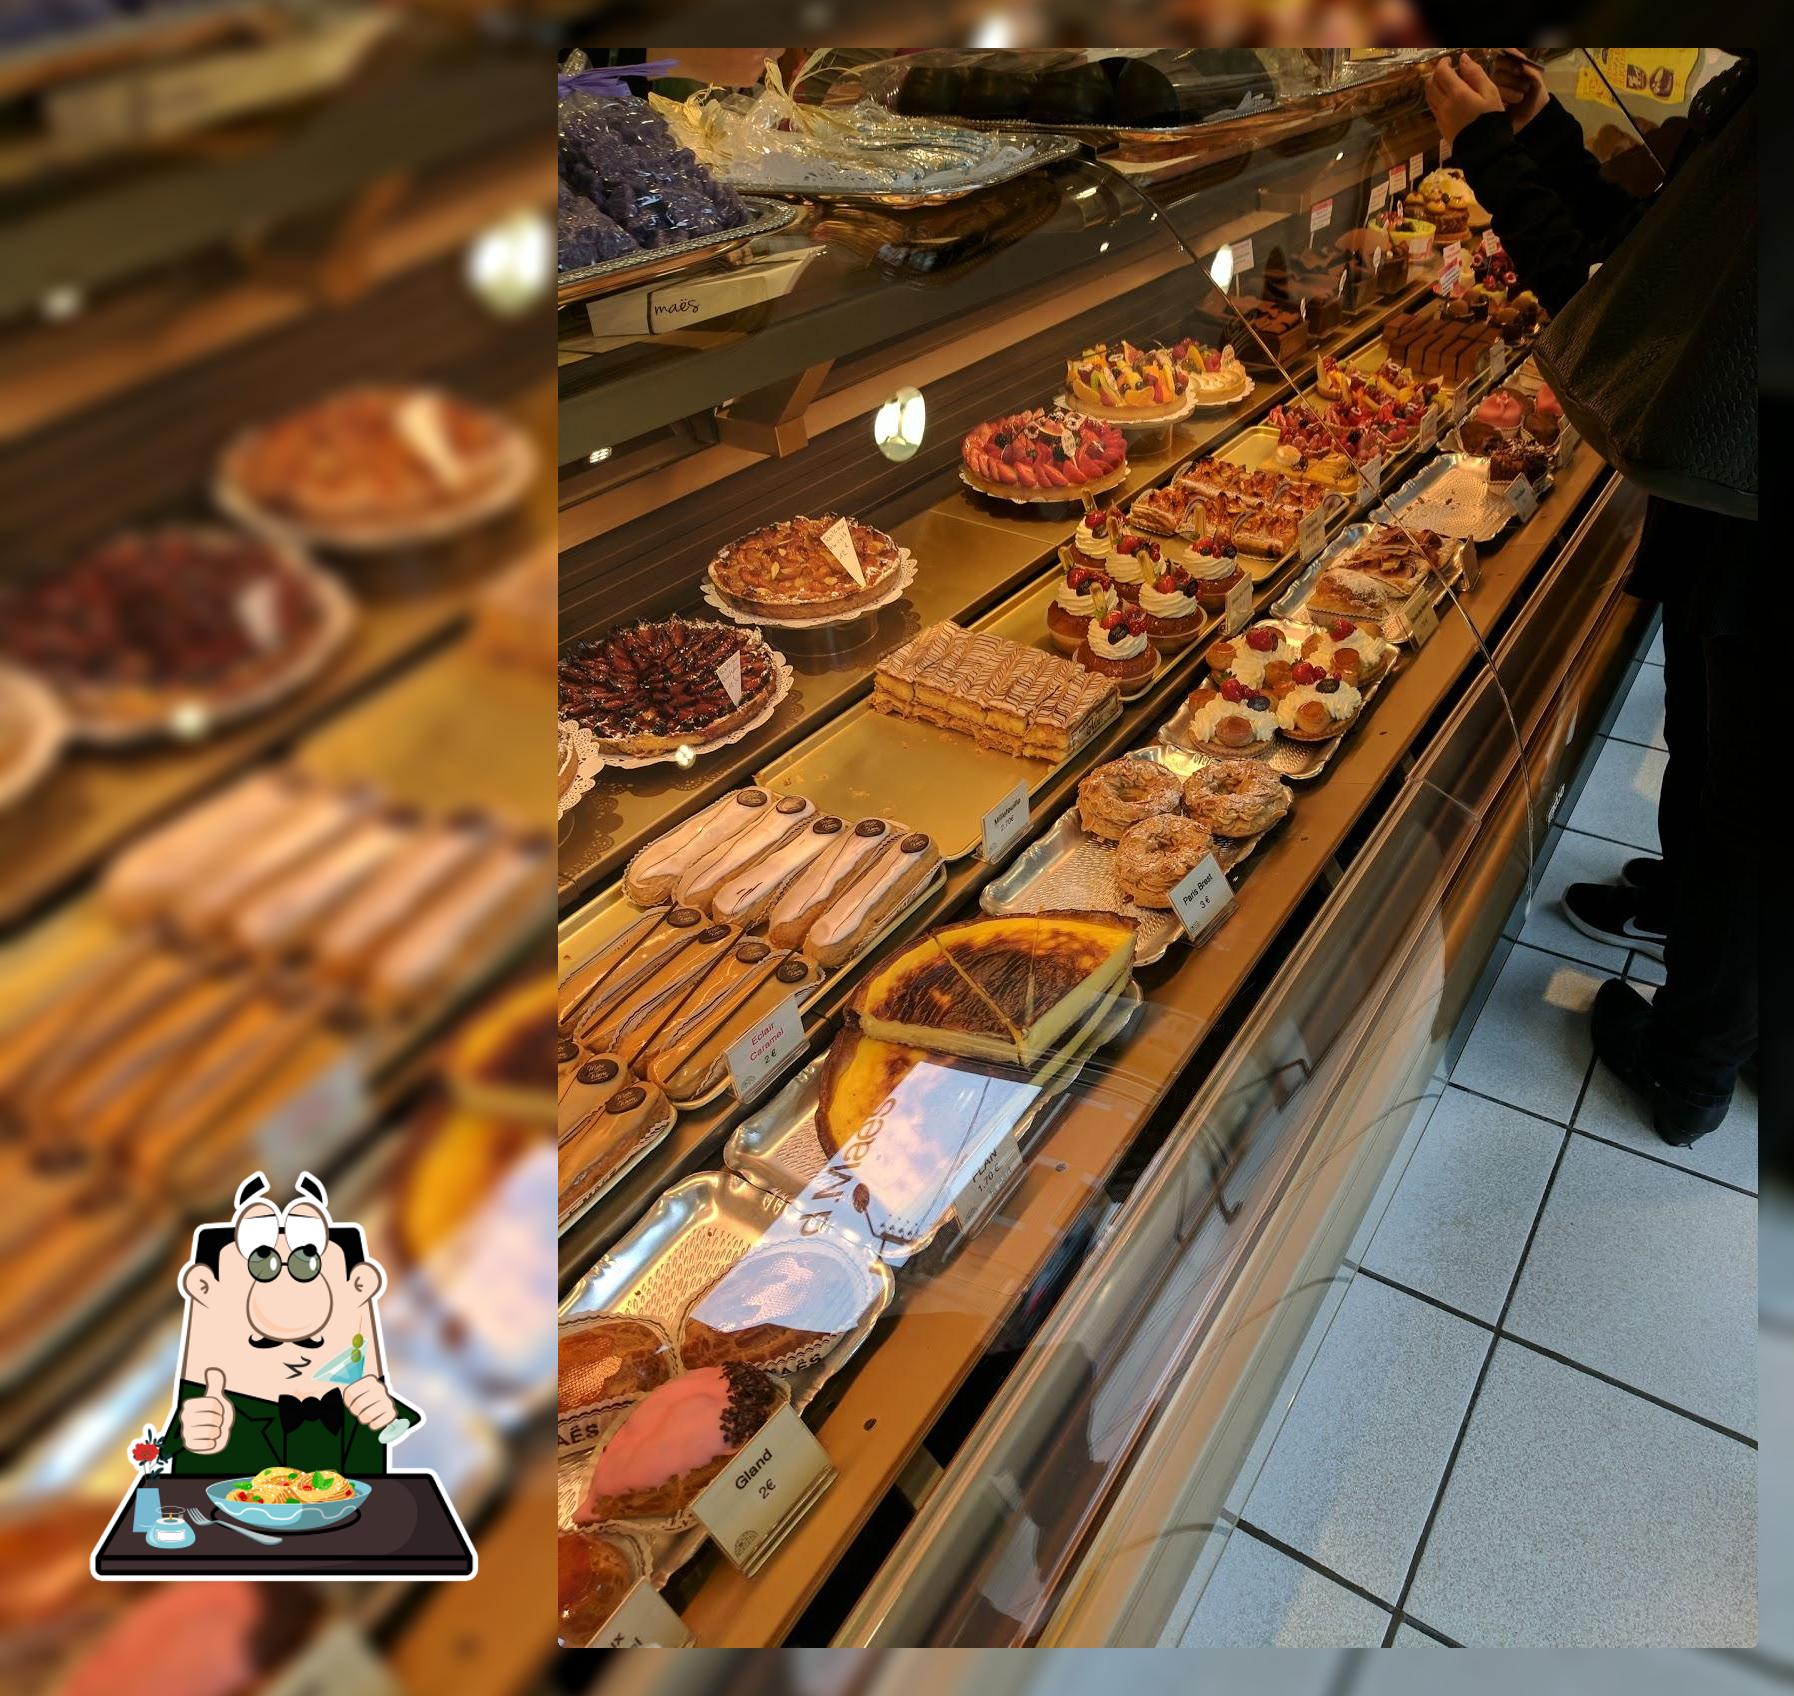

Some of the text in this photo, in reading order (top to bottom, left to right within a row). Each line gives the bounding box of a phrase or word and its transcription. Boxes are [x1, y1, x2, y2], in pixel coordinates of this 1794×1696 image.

[1182, 888, 1199, 906] Paris
[1197, 873, 1213, 891] Brest
[750, 1027, 784, 1061] Caramel
[764, 1054, 771, 1064] 2
[735, 1447, 773, 1490] Gland
[758, 1478, 776, 1500] 2€
